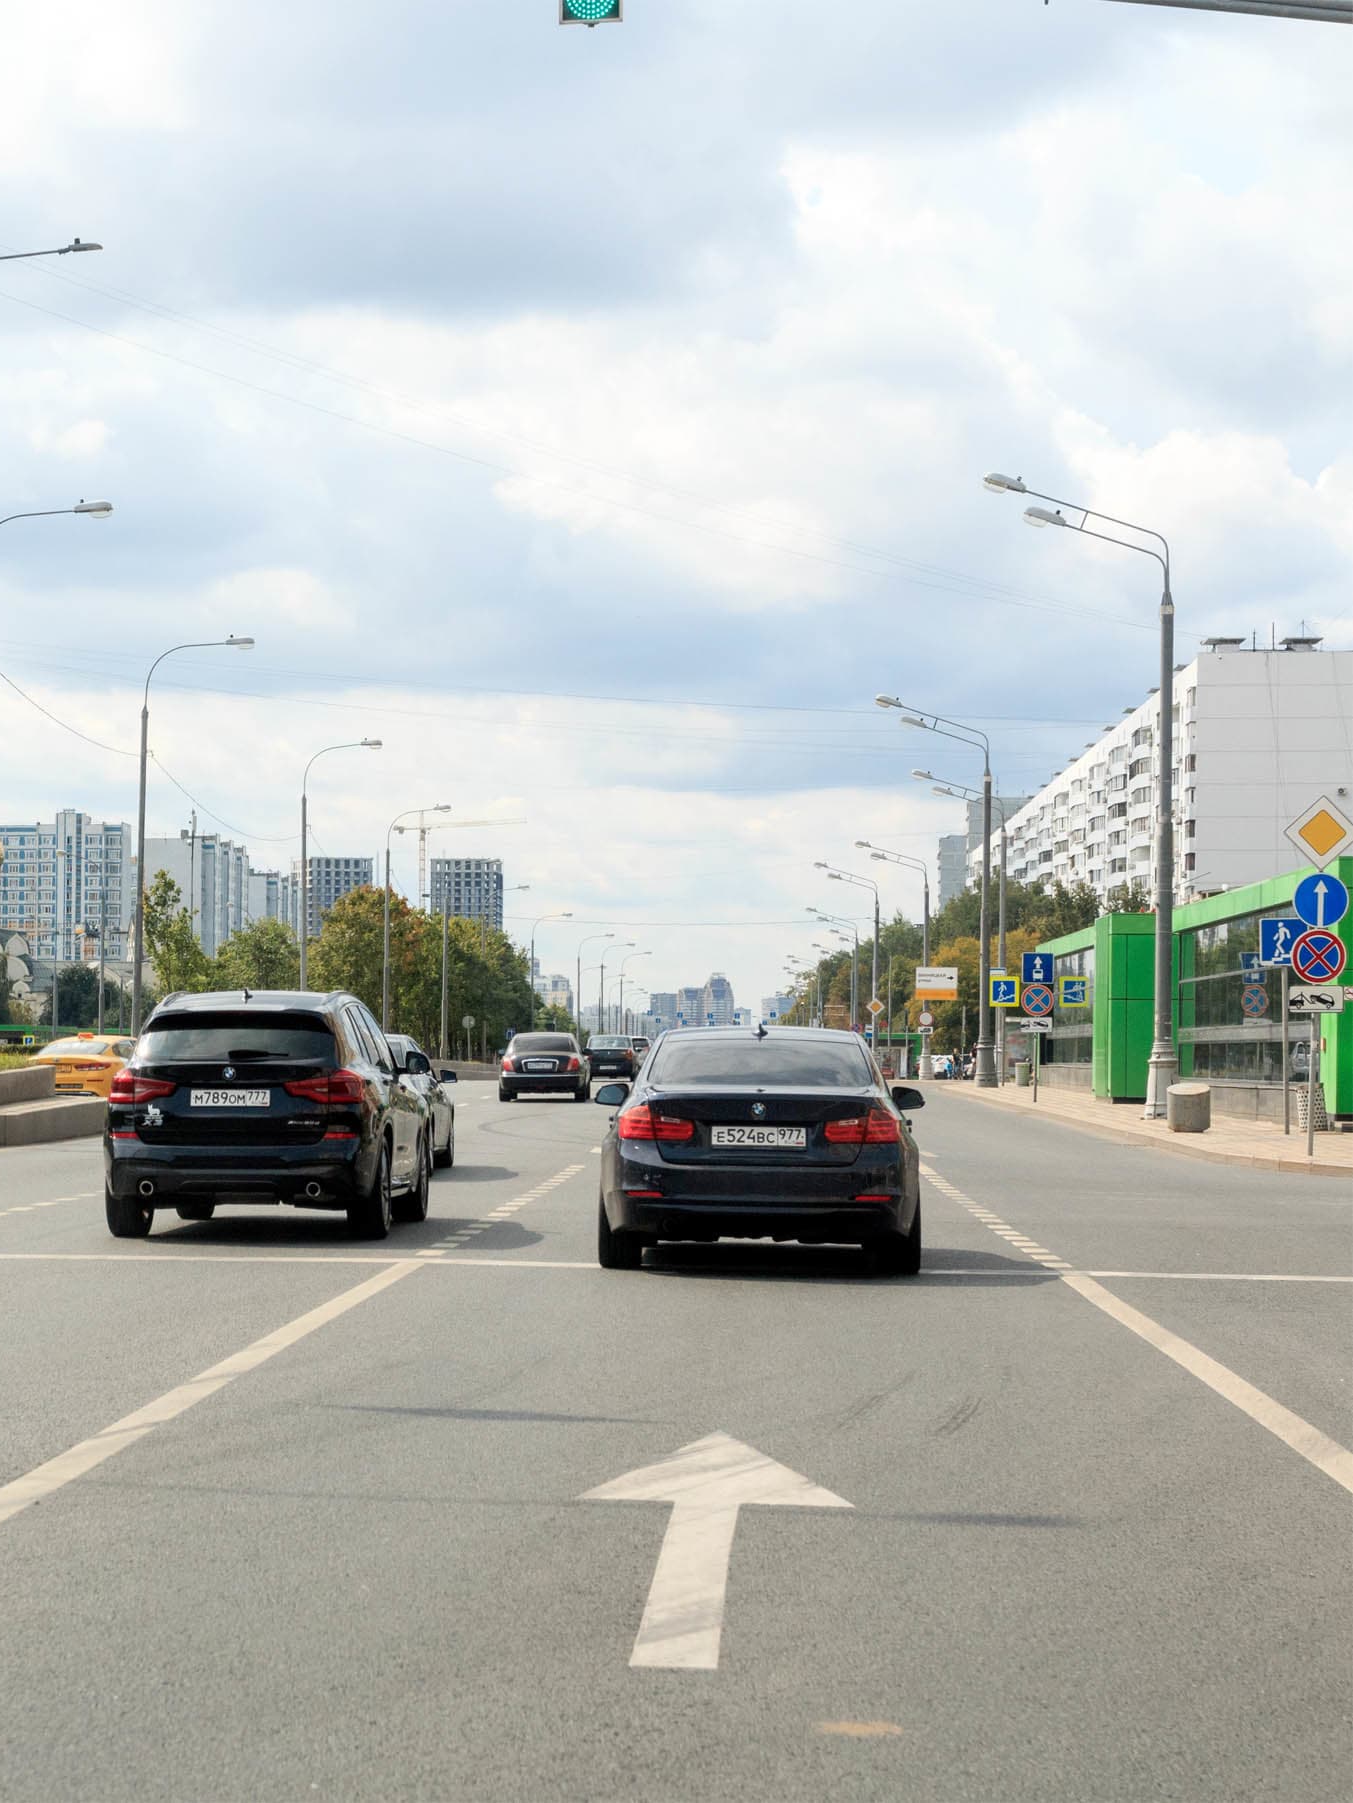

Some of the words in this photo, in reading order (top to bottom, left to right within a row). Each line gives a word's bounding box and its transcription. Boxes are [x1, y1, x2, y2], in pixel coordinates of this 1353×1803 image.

[194, 1091, 246, 1105] М789ОМ
[248, 1091, 267, 1101] 777
[716, 1128, 775, 1144] Е524ВС
[778, 1128, 802, 1141] 977
